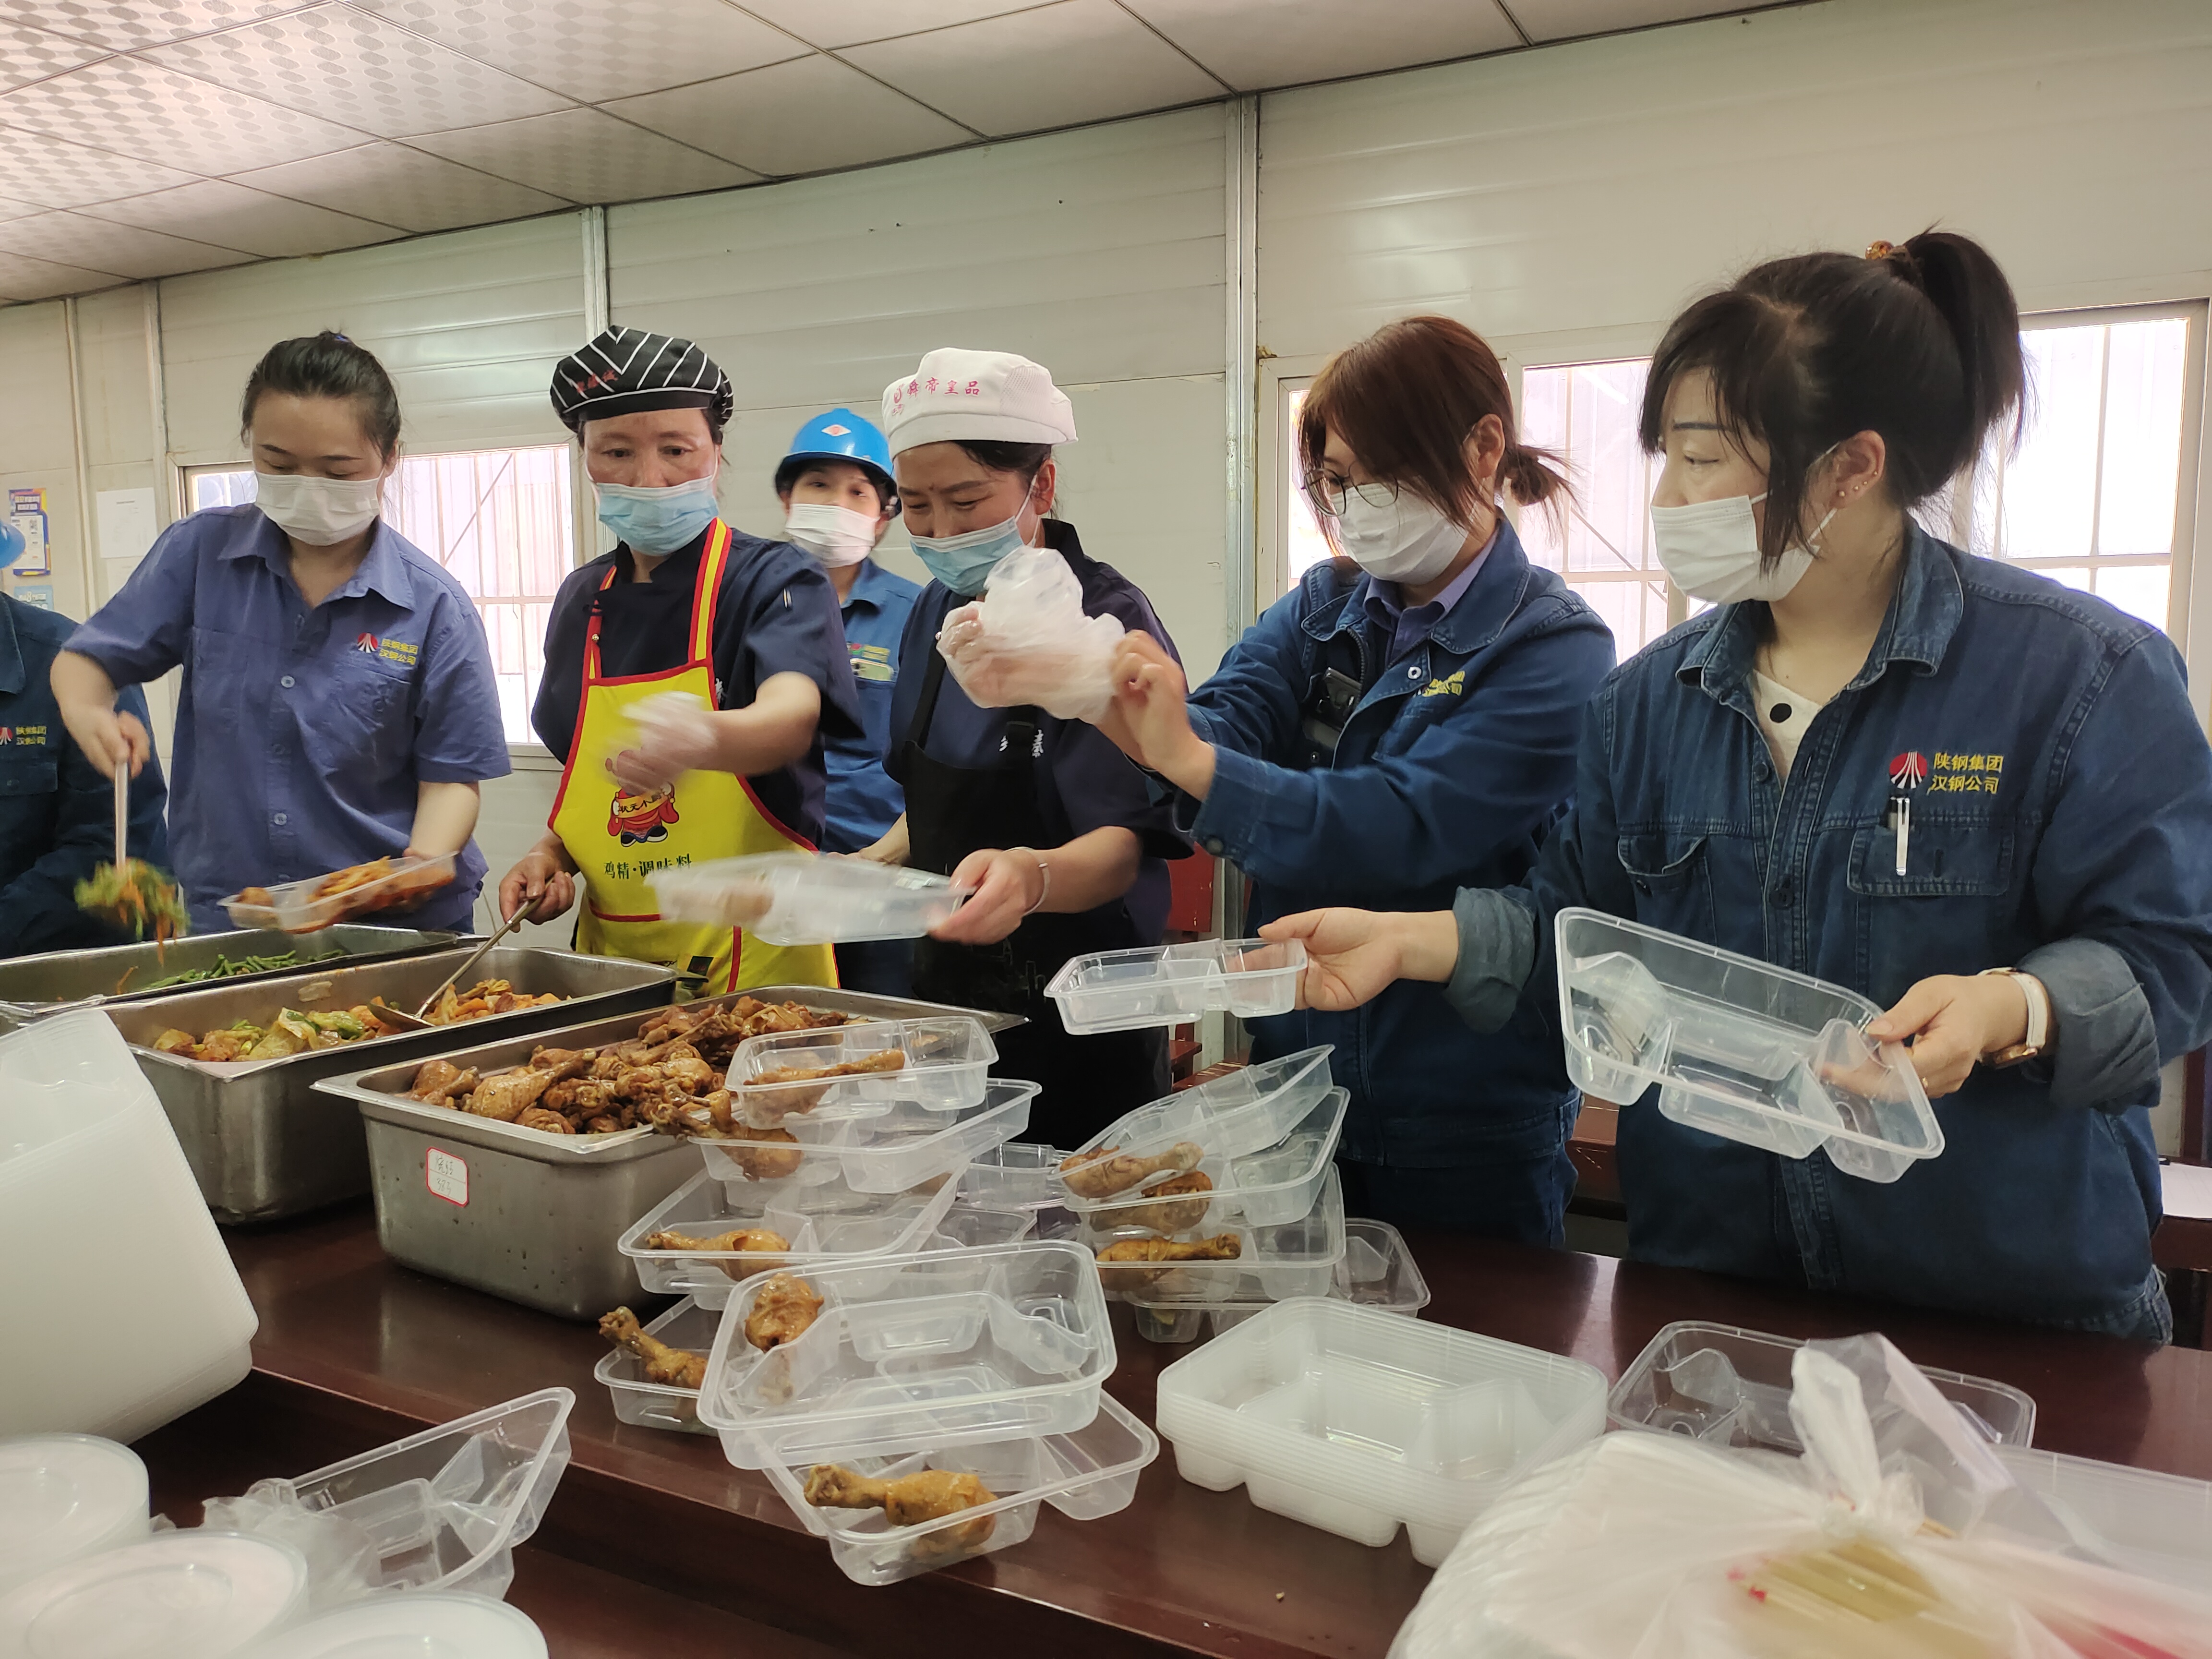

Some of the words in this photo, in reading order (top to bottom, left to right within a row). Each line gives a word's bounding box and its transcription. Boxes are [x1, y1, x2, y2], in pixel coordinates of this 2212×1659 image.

[1933, 752, 2004, 773] 陕钢集团
[1928, 774, 1999, 794] 汉钢公司
